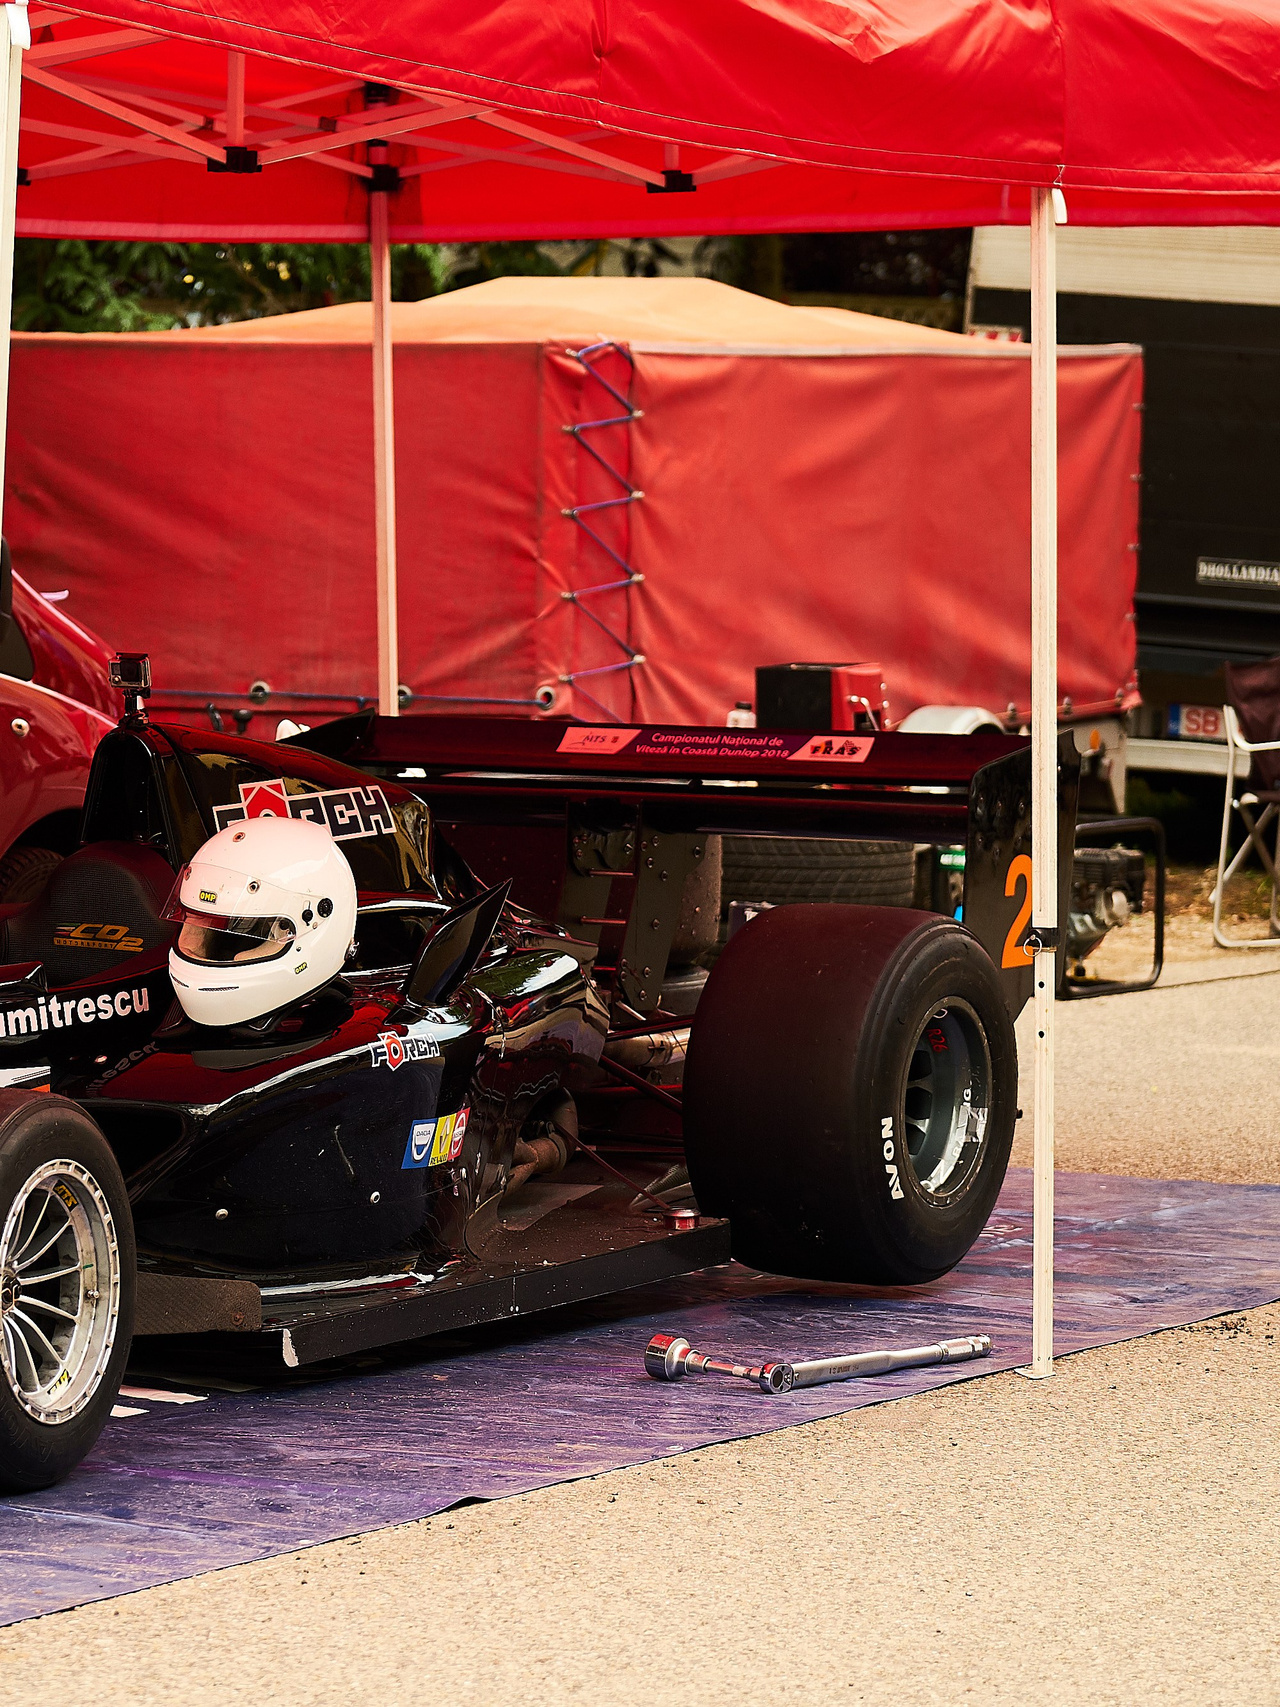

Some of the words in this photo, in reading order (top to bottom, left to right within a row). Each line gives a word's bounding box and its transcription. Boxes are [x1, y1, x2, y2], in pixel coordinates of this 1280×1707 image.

[1198, 561, 1279, 582] DHOLLANDIA
[1185, 708, 1219, 734] SB
[651, 732, 720, 745] Campionatul
[768, 736, 785, 746] de
[718, 747, 760, 758] Dunlop
[760, 749, 790, 759] 2018
[199, 890, 217, 903] OMP
[1001, 853, 1033, 969] 2
[53, 937, 117, 949] MOTORSPORT
[295, 961, 308, 974] OMP
[880, 1116, 905, 1200] AVON
